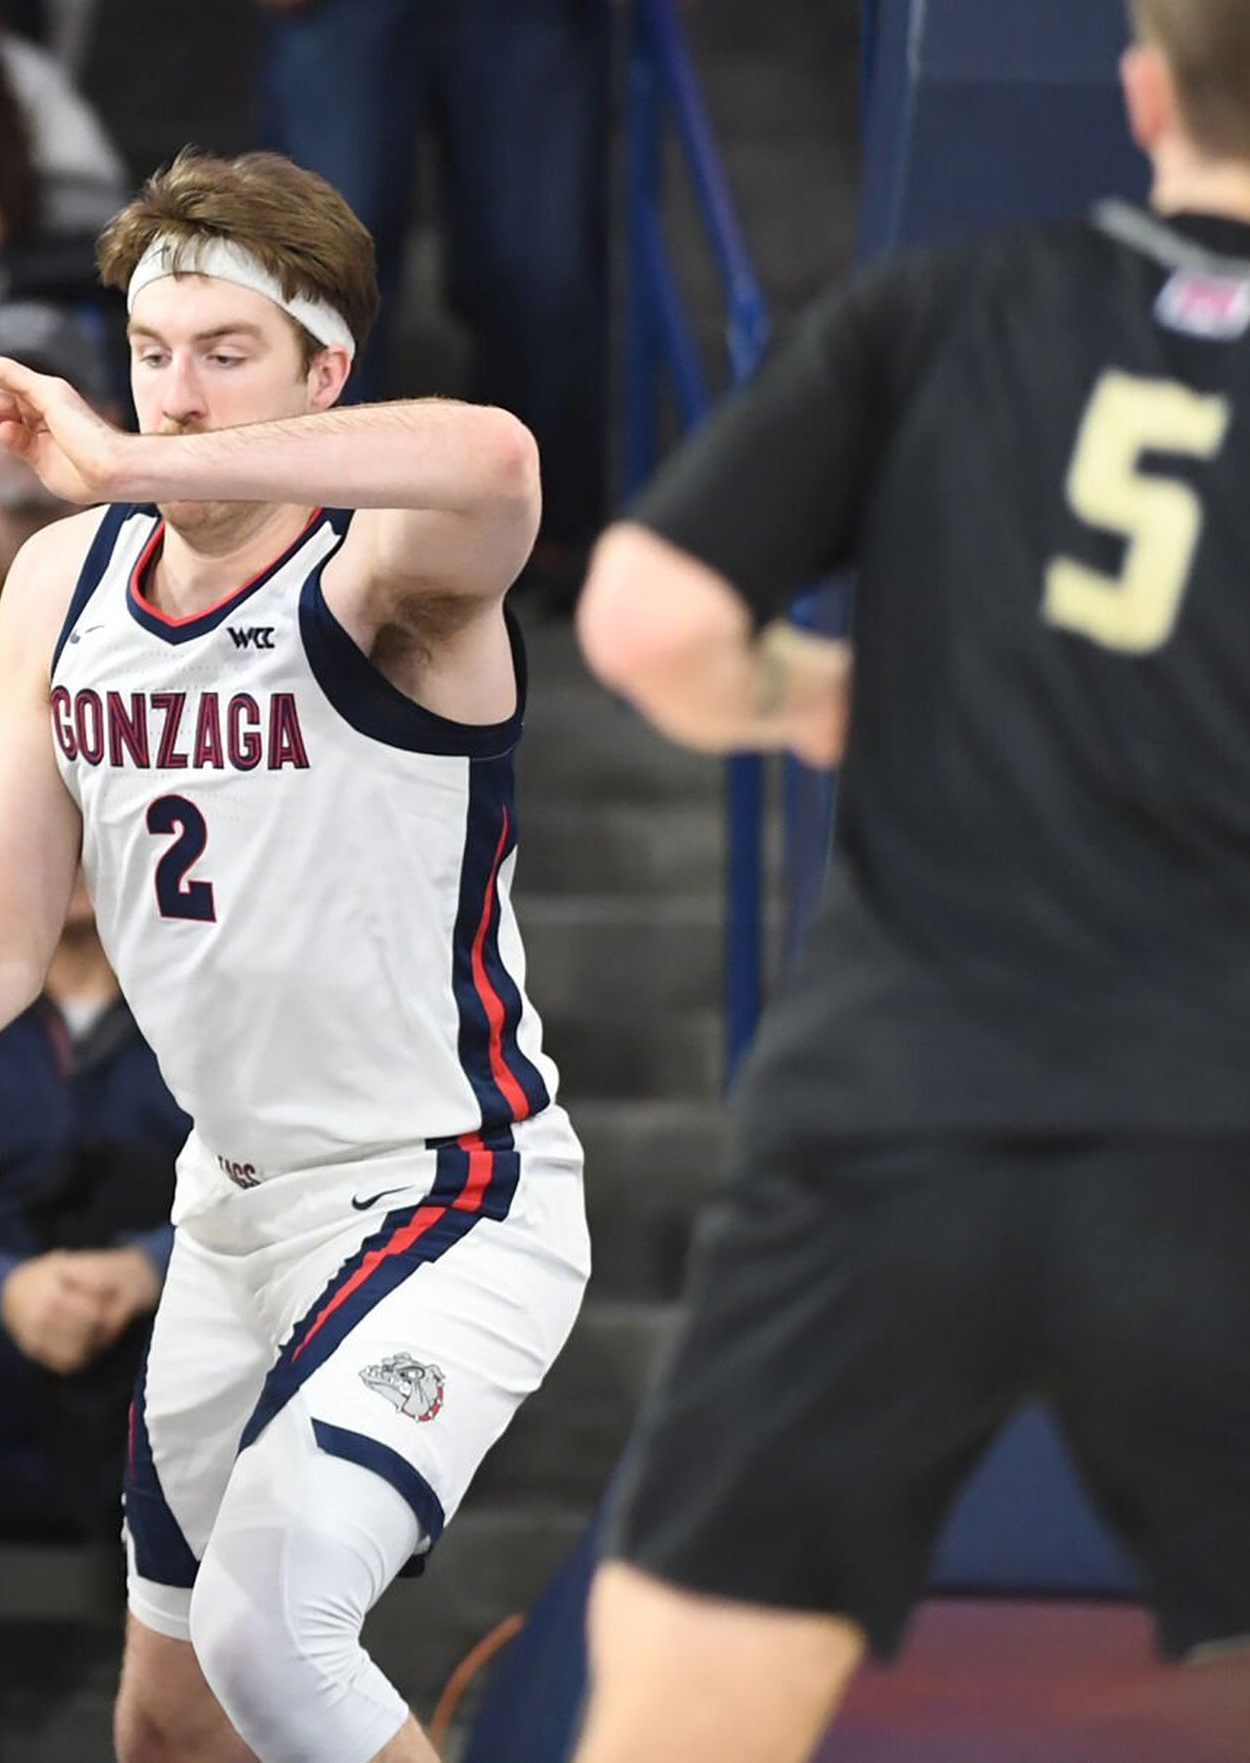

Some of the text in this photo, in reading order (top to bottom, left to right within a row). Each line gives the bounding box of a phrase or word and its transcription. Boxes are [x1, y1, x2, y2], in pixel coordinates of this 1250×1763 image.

[1041, 367, 1231, 656] 5
[226, 625, 276, 649] WCC
[51, 684, 311, 770] GONZAGA
[146, 793, 217, 923] 2
